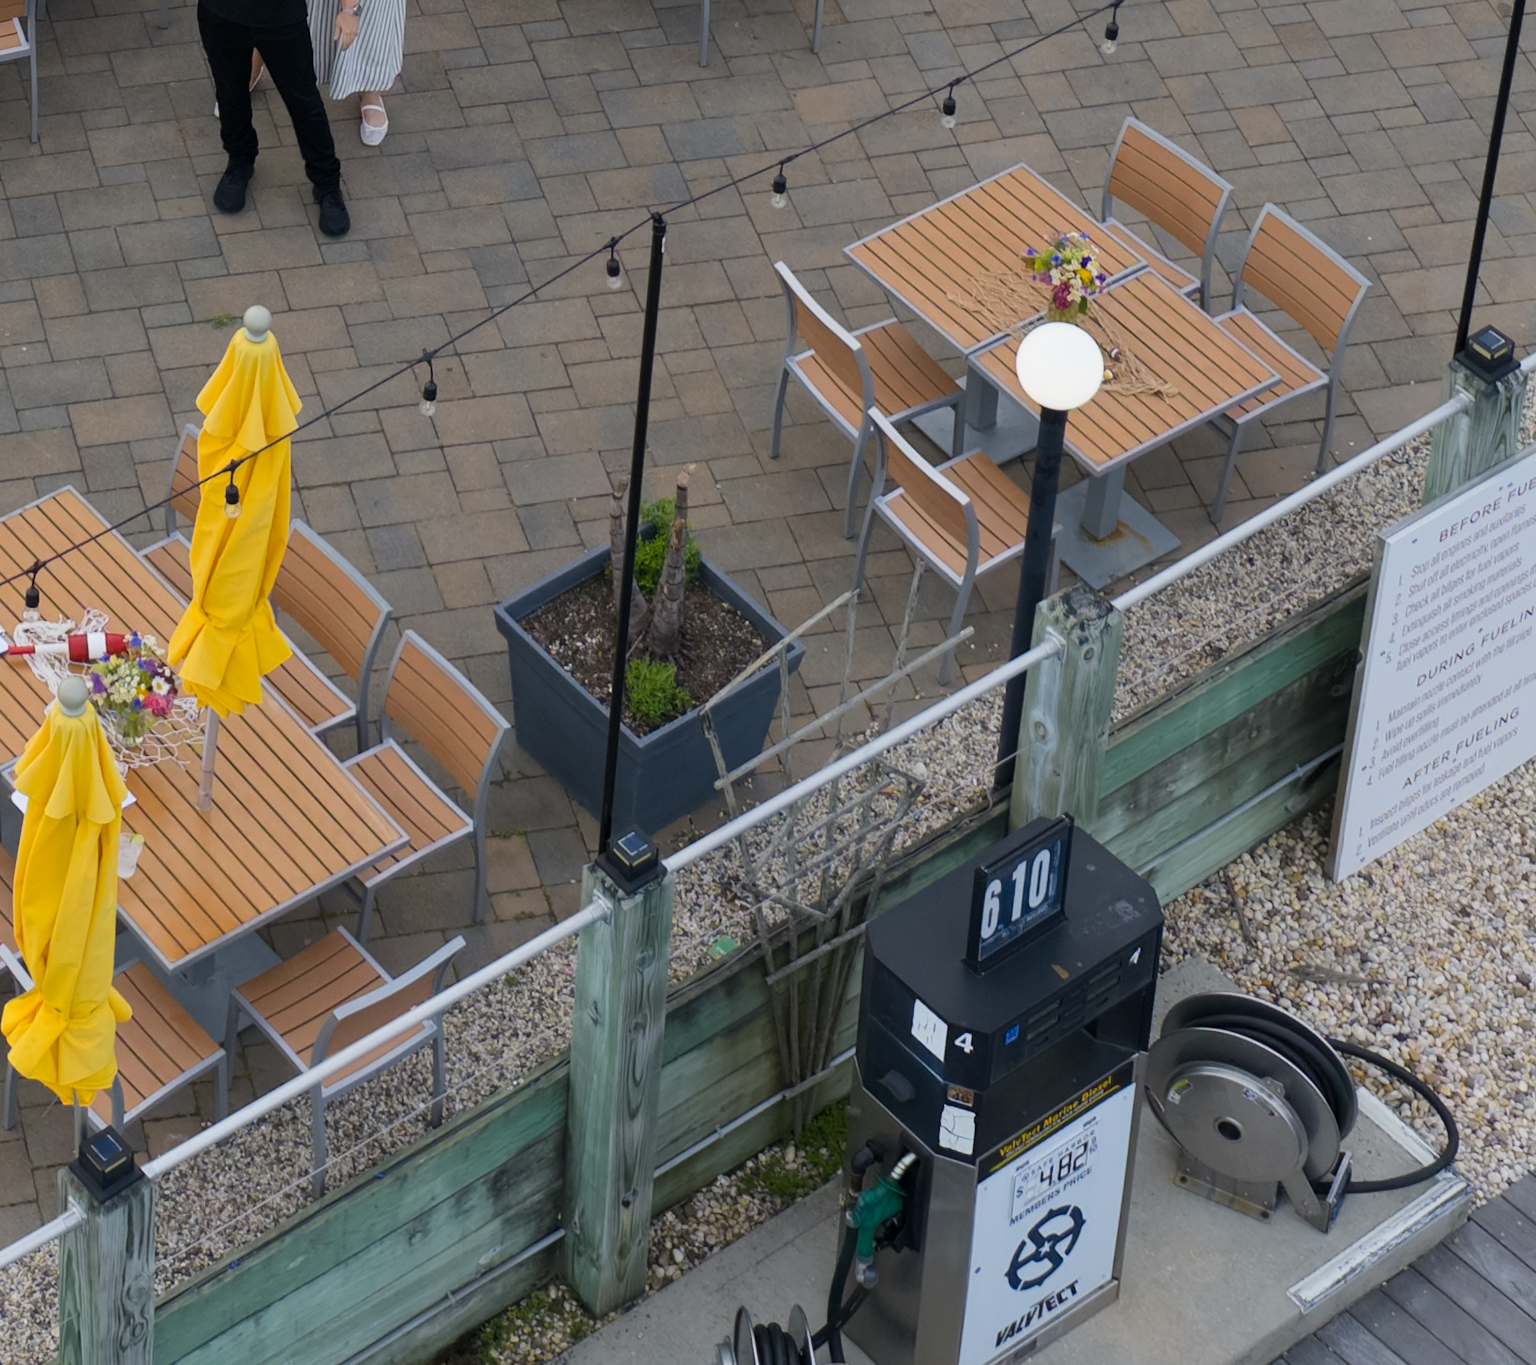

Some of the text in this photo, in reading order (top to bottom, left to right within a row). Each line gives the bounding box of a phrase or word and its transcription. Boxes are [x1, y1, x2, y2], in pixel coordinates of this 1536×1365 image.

[1439, 497, 1501, 542] BEFORE
[1416, 642, 1474, 686] DURING
[1402, 706, 1519, 789] AFTER FUELING
[954, 1032, 974, 1054] 4
[1043, 1099, 1079, 1129] Marine
[1081, 1075, 1113, 1102] Diesel
[1009, 1167, 1091, 1226] MEMBERS PRICE
[995, 1279, 1079, 1349] VALVTECT
